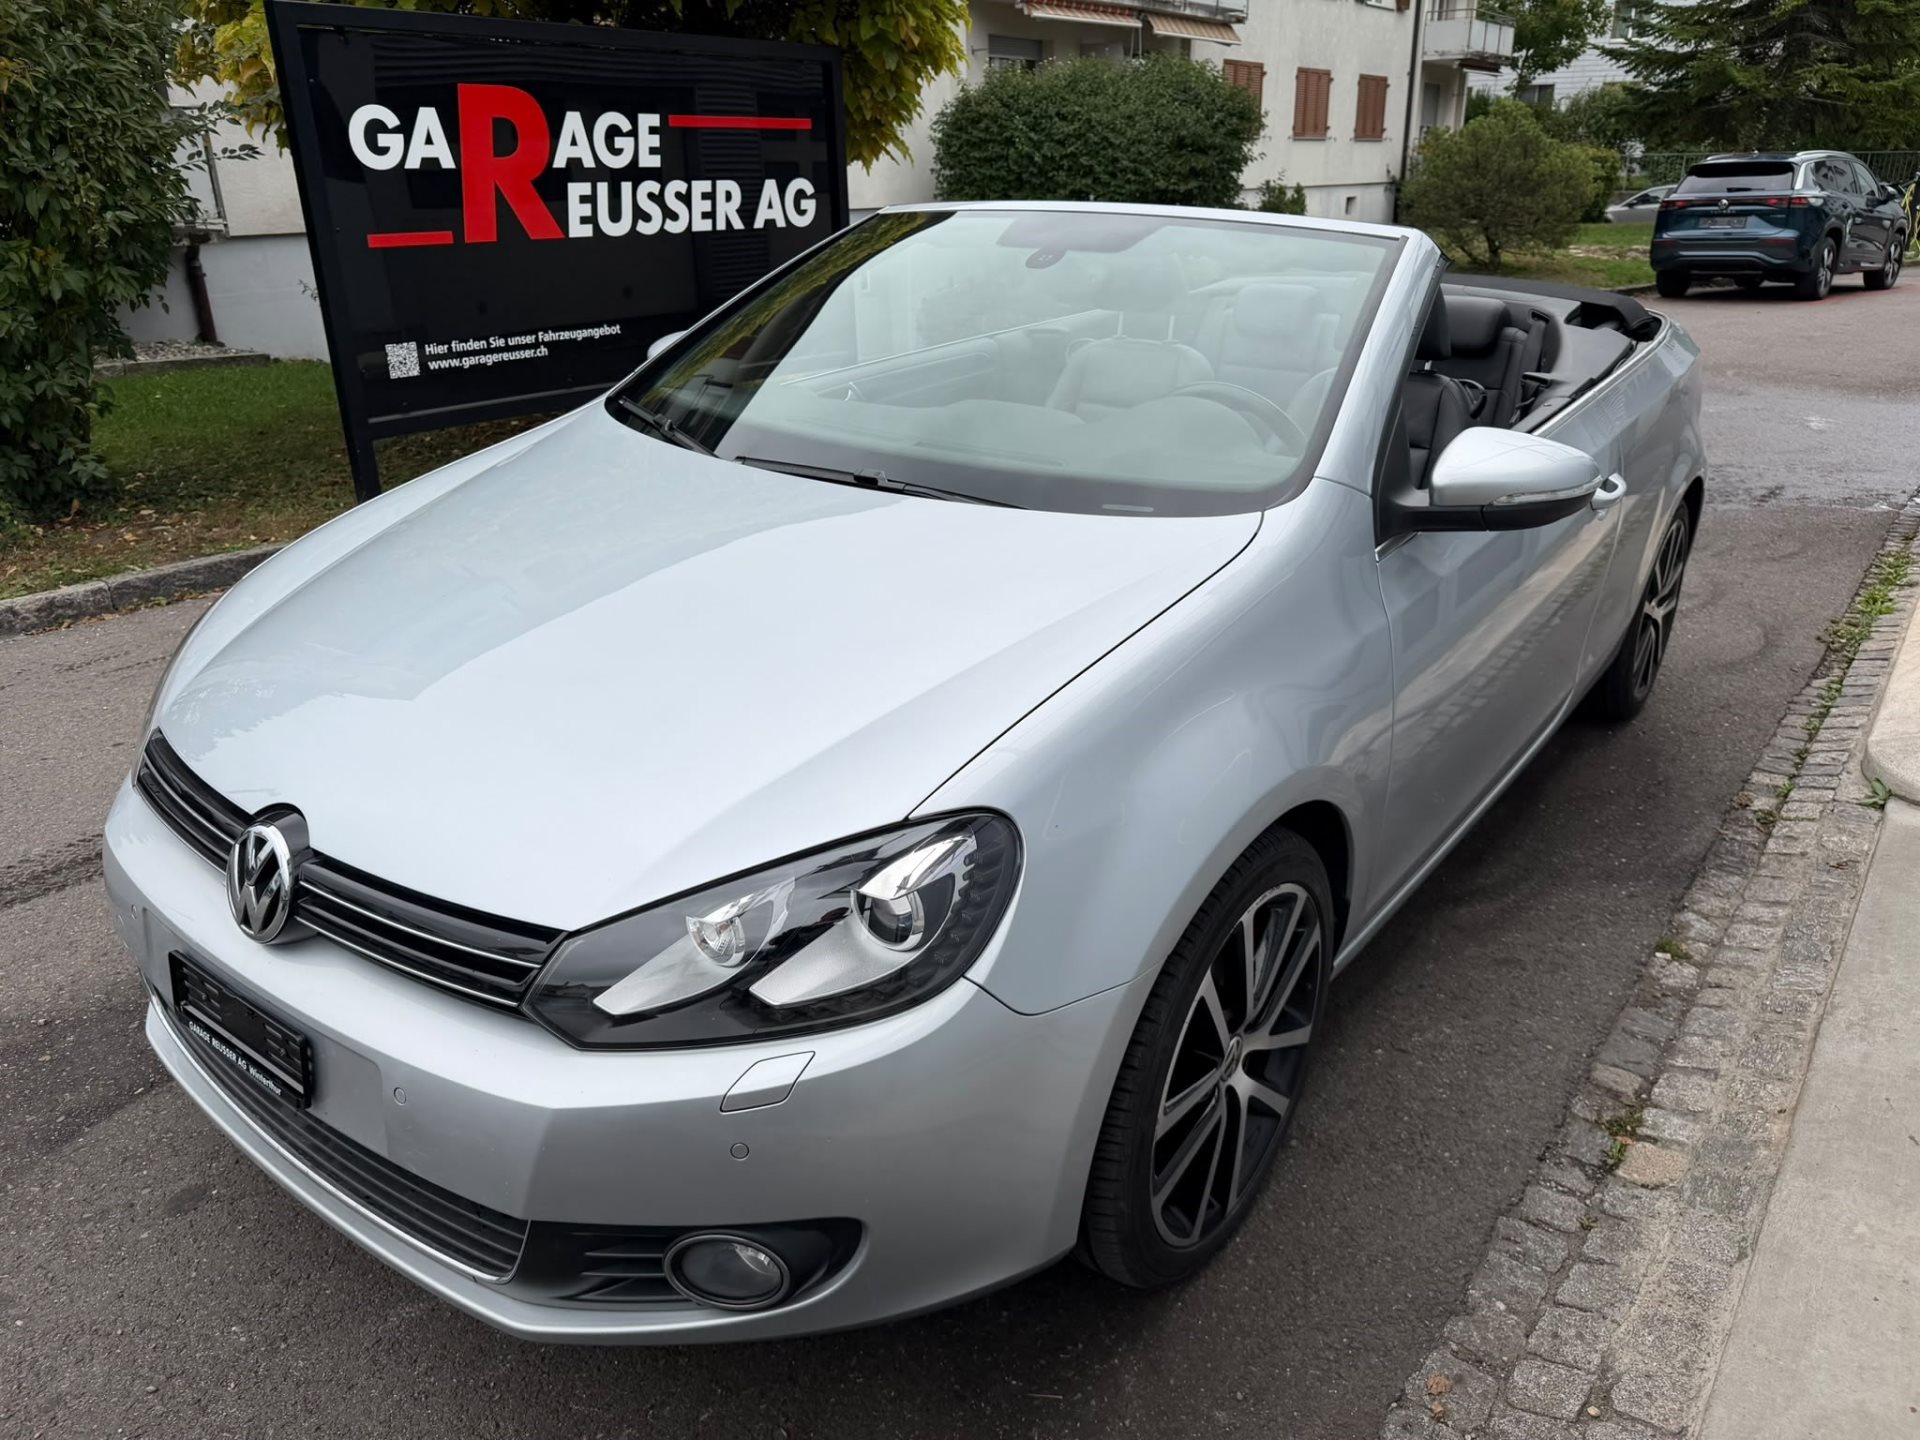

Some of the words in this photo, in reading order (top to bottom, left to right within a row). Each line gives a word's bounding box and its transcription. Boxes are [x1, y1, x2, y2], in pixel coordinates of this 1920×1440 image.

[754, 177, 816, 229] AG
[425, 342, 449, 356] Hier
[451, 338, 487, 353] finden
[489, 336, 506, 348] Sie
[508, 334, 536, 346] unser
[538, 324, 621, 343] Fahrzeugangebot
[428, 345, 549, 370] www.garagereusser.ch
[188, 1020, 211, 1044] GARAGE
[211, 1037, 237, 1063] REUSSER
[238, 1056, 248, 1071] AG
[248, 1064, 282, 1096] Winterthur
